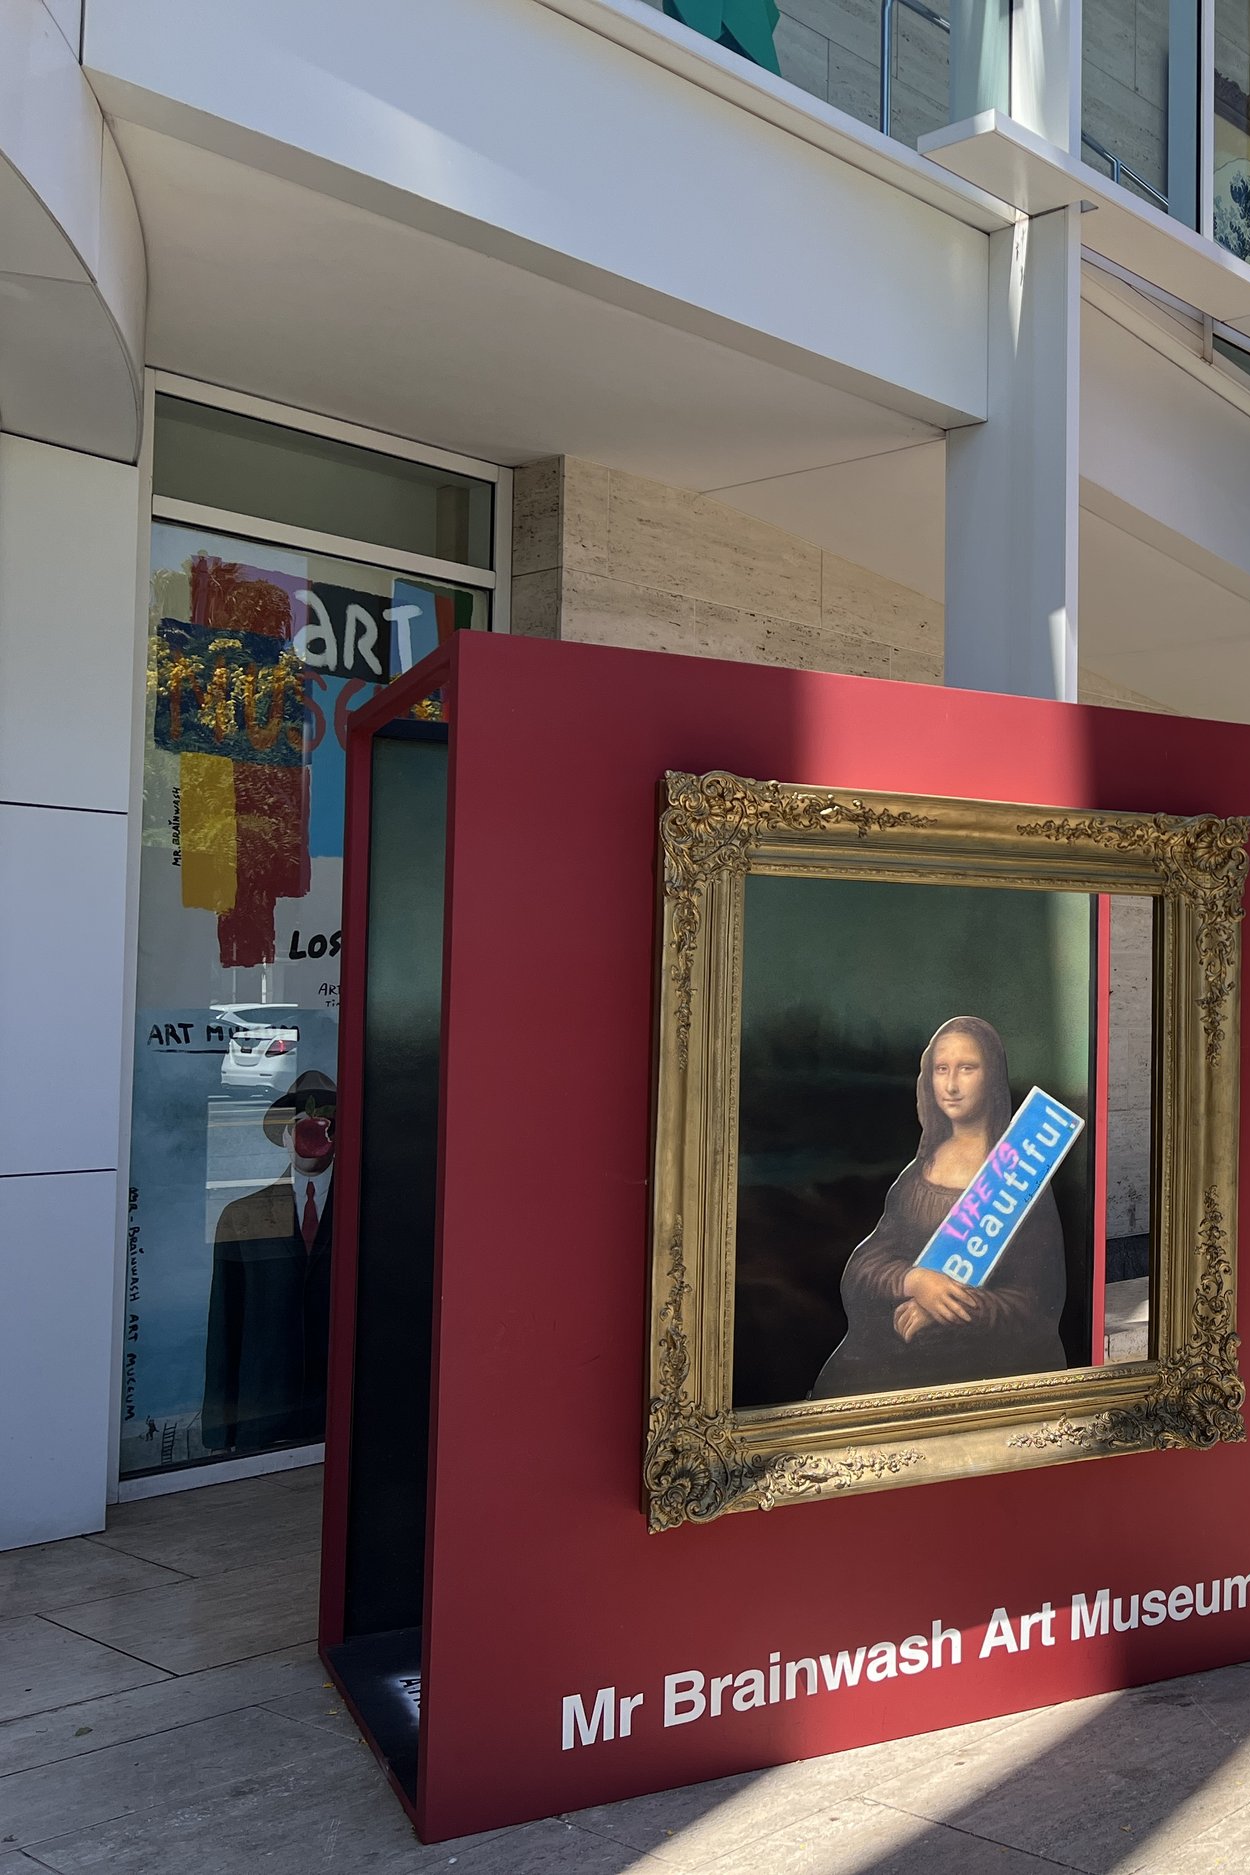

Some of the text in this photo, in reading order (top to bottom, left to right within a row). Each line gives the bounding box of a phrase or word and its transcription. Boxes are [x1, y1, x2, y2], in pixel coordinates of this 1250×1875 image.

[147, 1023, 194, 1046] ART
[942, 1105, 1068, 1284] Beautiful
[943, 1174, 993, 1241] LIFE
[128, 1314, 140, 1342] ART
[562, 1686, 644, 1750] Mr
[664, 1619, 962, 1728] Brainwash
[978, 1602, 1056, 1659] Art
